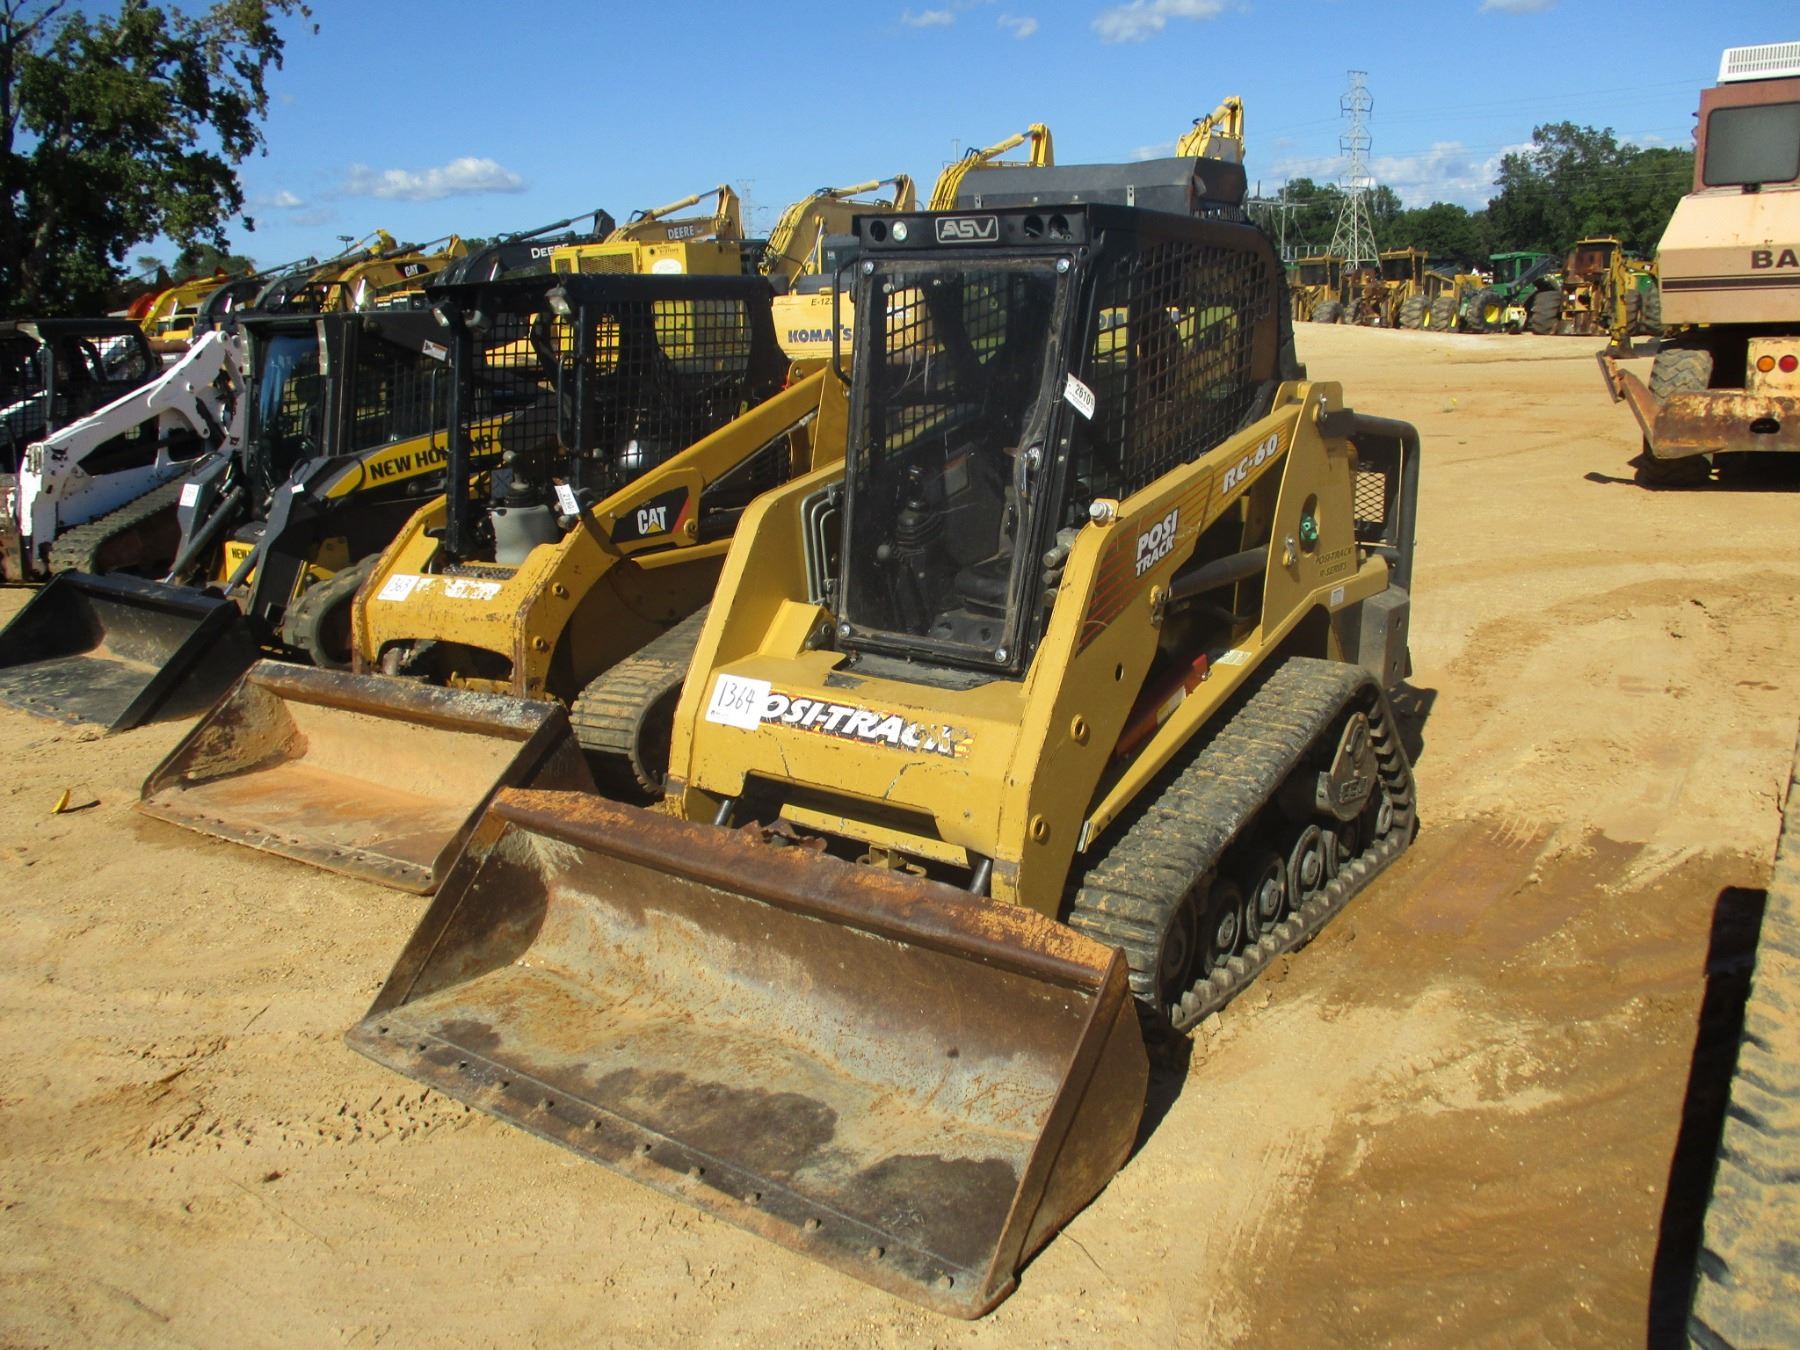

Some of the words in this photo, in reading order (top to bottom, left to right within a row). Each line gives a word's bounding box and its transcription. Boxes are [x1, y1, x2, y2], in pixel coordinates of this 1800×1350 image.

[667, 225, 695, 240] DEERE
[940, 218, 995, 240] ASV
[404, 264, 419, 277] CAT
[810, 297, 833, 306] E-12
[787, 324, 852, 343] KOMAS
[369, 452, 411, 480] NEW
[1222, 432, 1279, 494] RC-60
[636, 505, 667, 535] CAT
[1136, 508, 1178, 562] POSI
[1135, 534, 1175, 577] TRACK
[717, 681, 756, 715] 1364
[760, 692, 953, 754] OSI-TRACK
